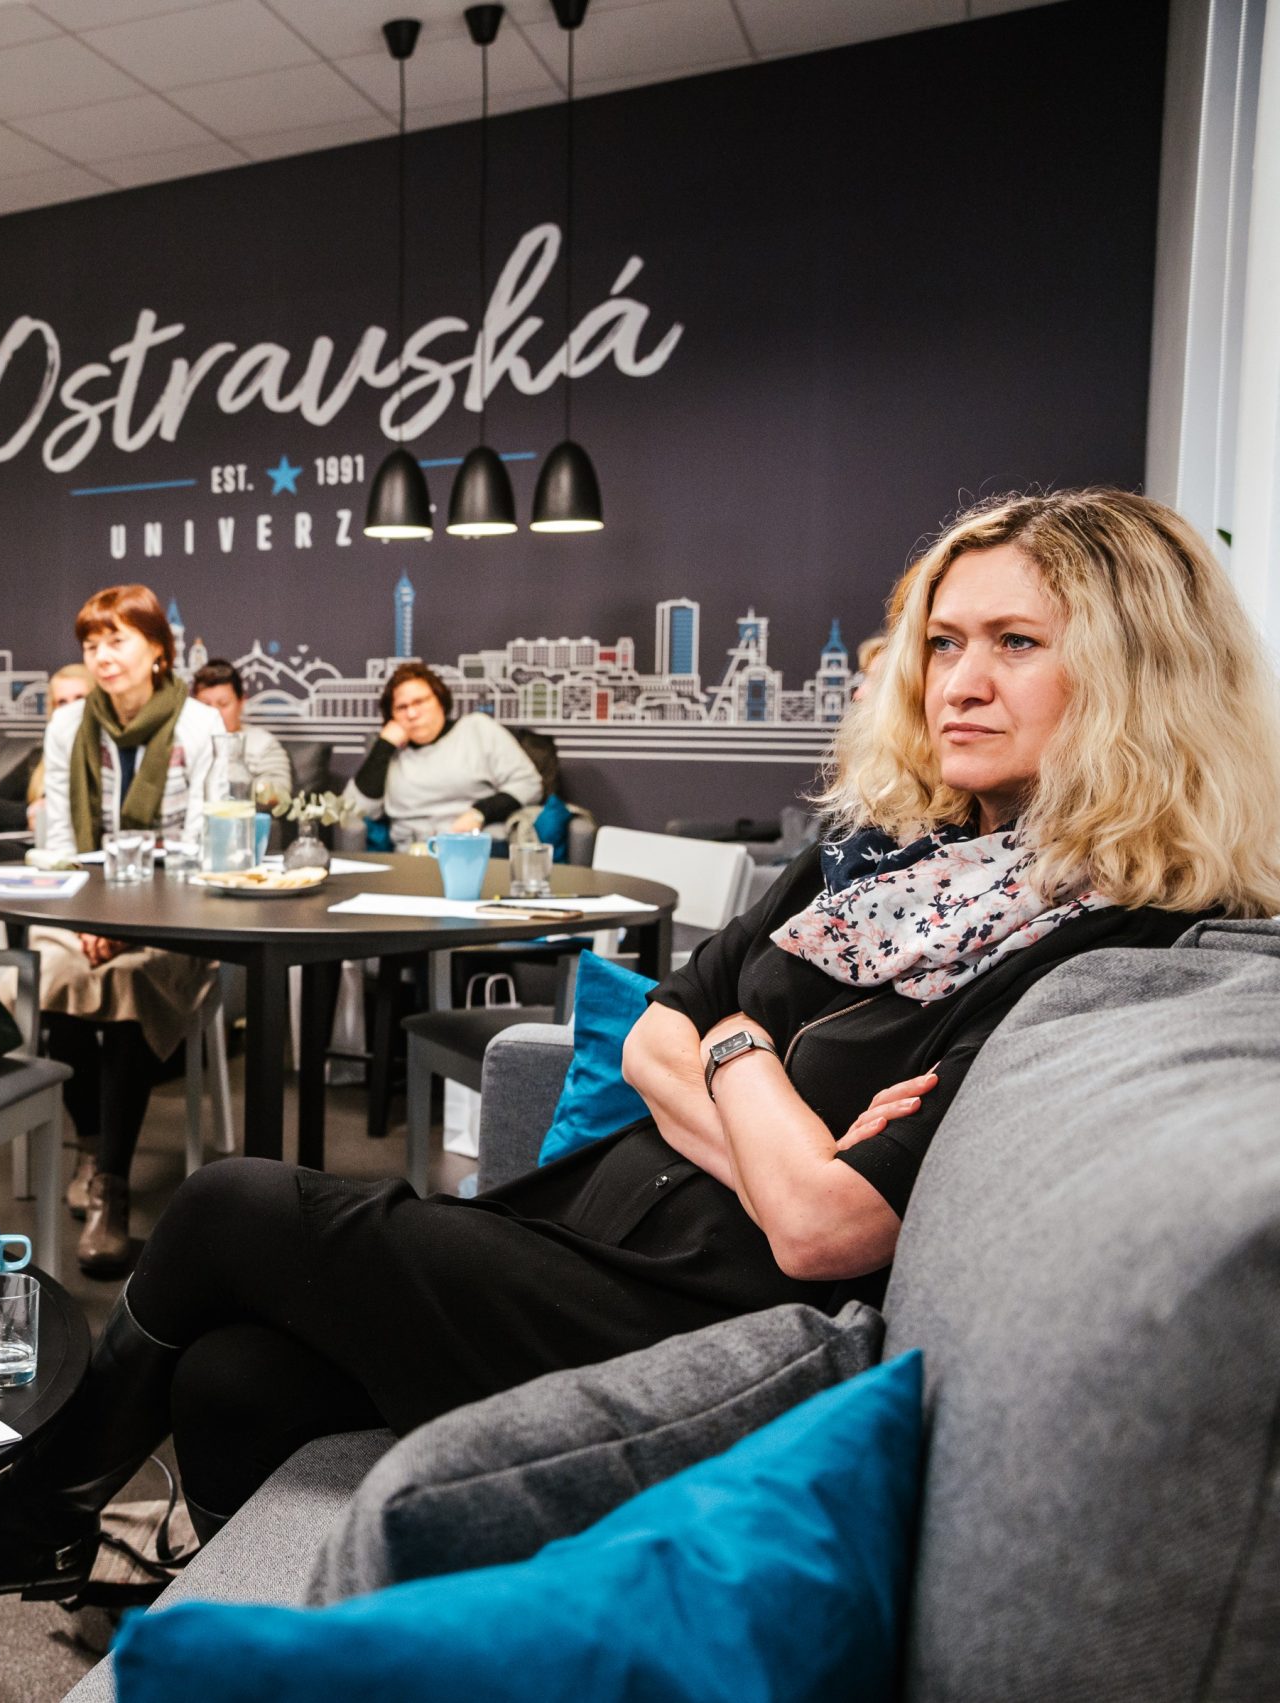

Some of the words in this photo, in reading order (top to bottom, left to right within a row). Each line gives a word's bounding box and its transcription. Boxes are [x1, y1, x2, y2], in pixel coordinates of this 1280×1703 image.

[211, 463, 255, 494] EST.
[315, 454, 365, 486] 1991
[110, 505, 484, 559] UNIVERZ
